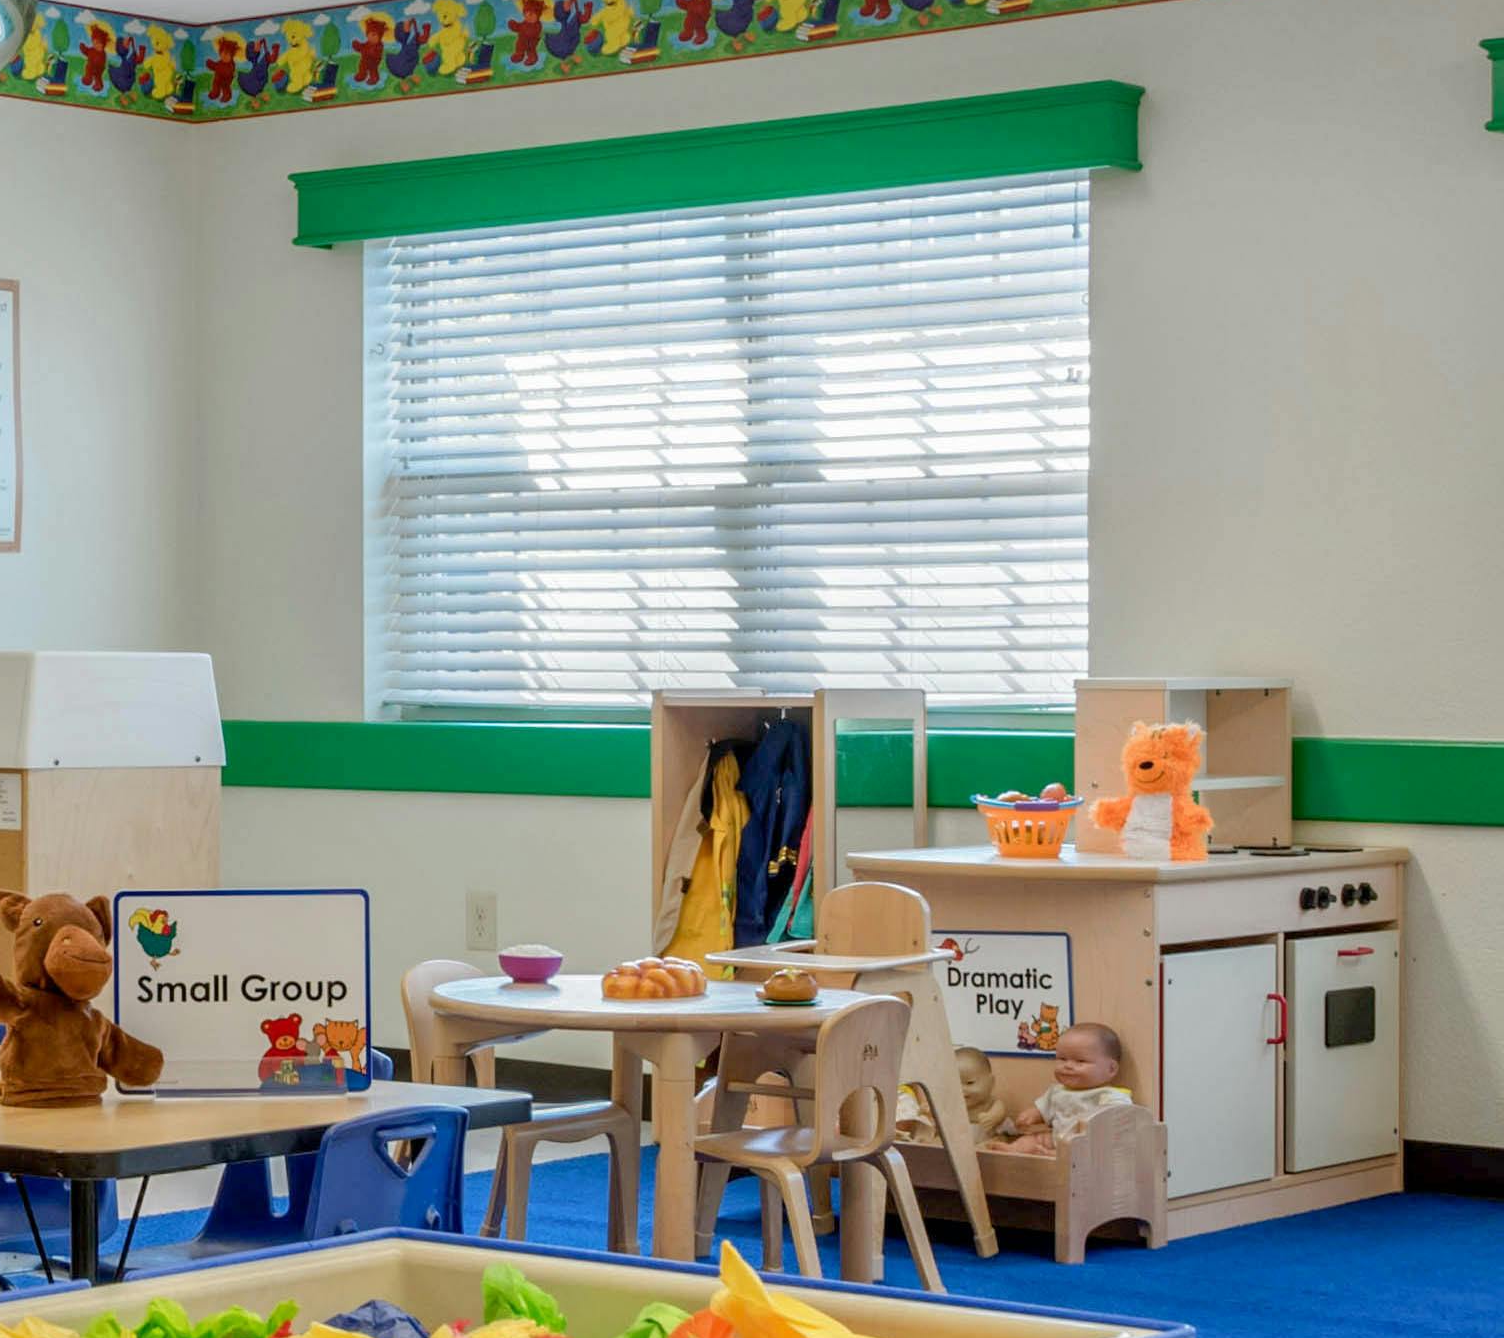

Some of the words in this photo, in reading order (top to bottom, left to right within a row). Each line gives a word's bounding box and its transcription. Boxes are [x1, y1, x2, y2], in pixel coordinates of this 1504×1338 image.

[947, 967, 1053, 989] Dramatic
[137, 975, 228, 1003] Small
[241, 975, 347, 1007] Group
[976, 994, 1024, 1019] Play
